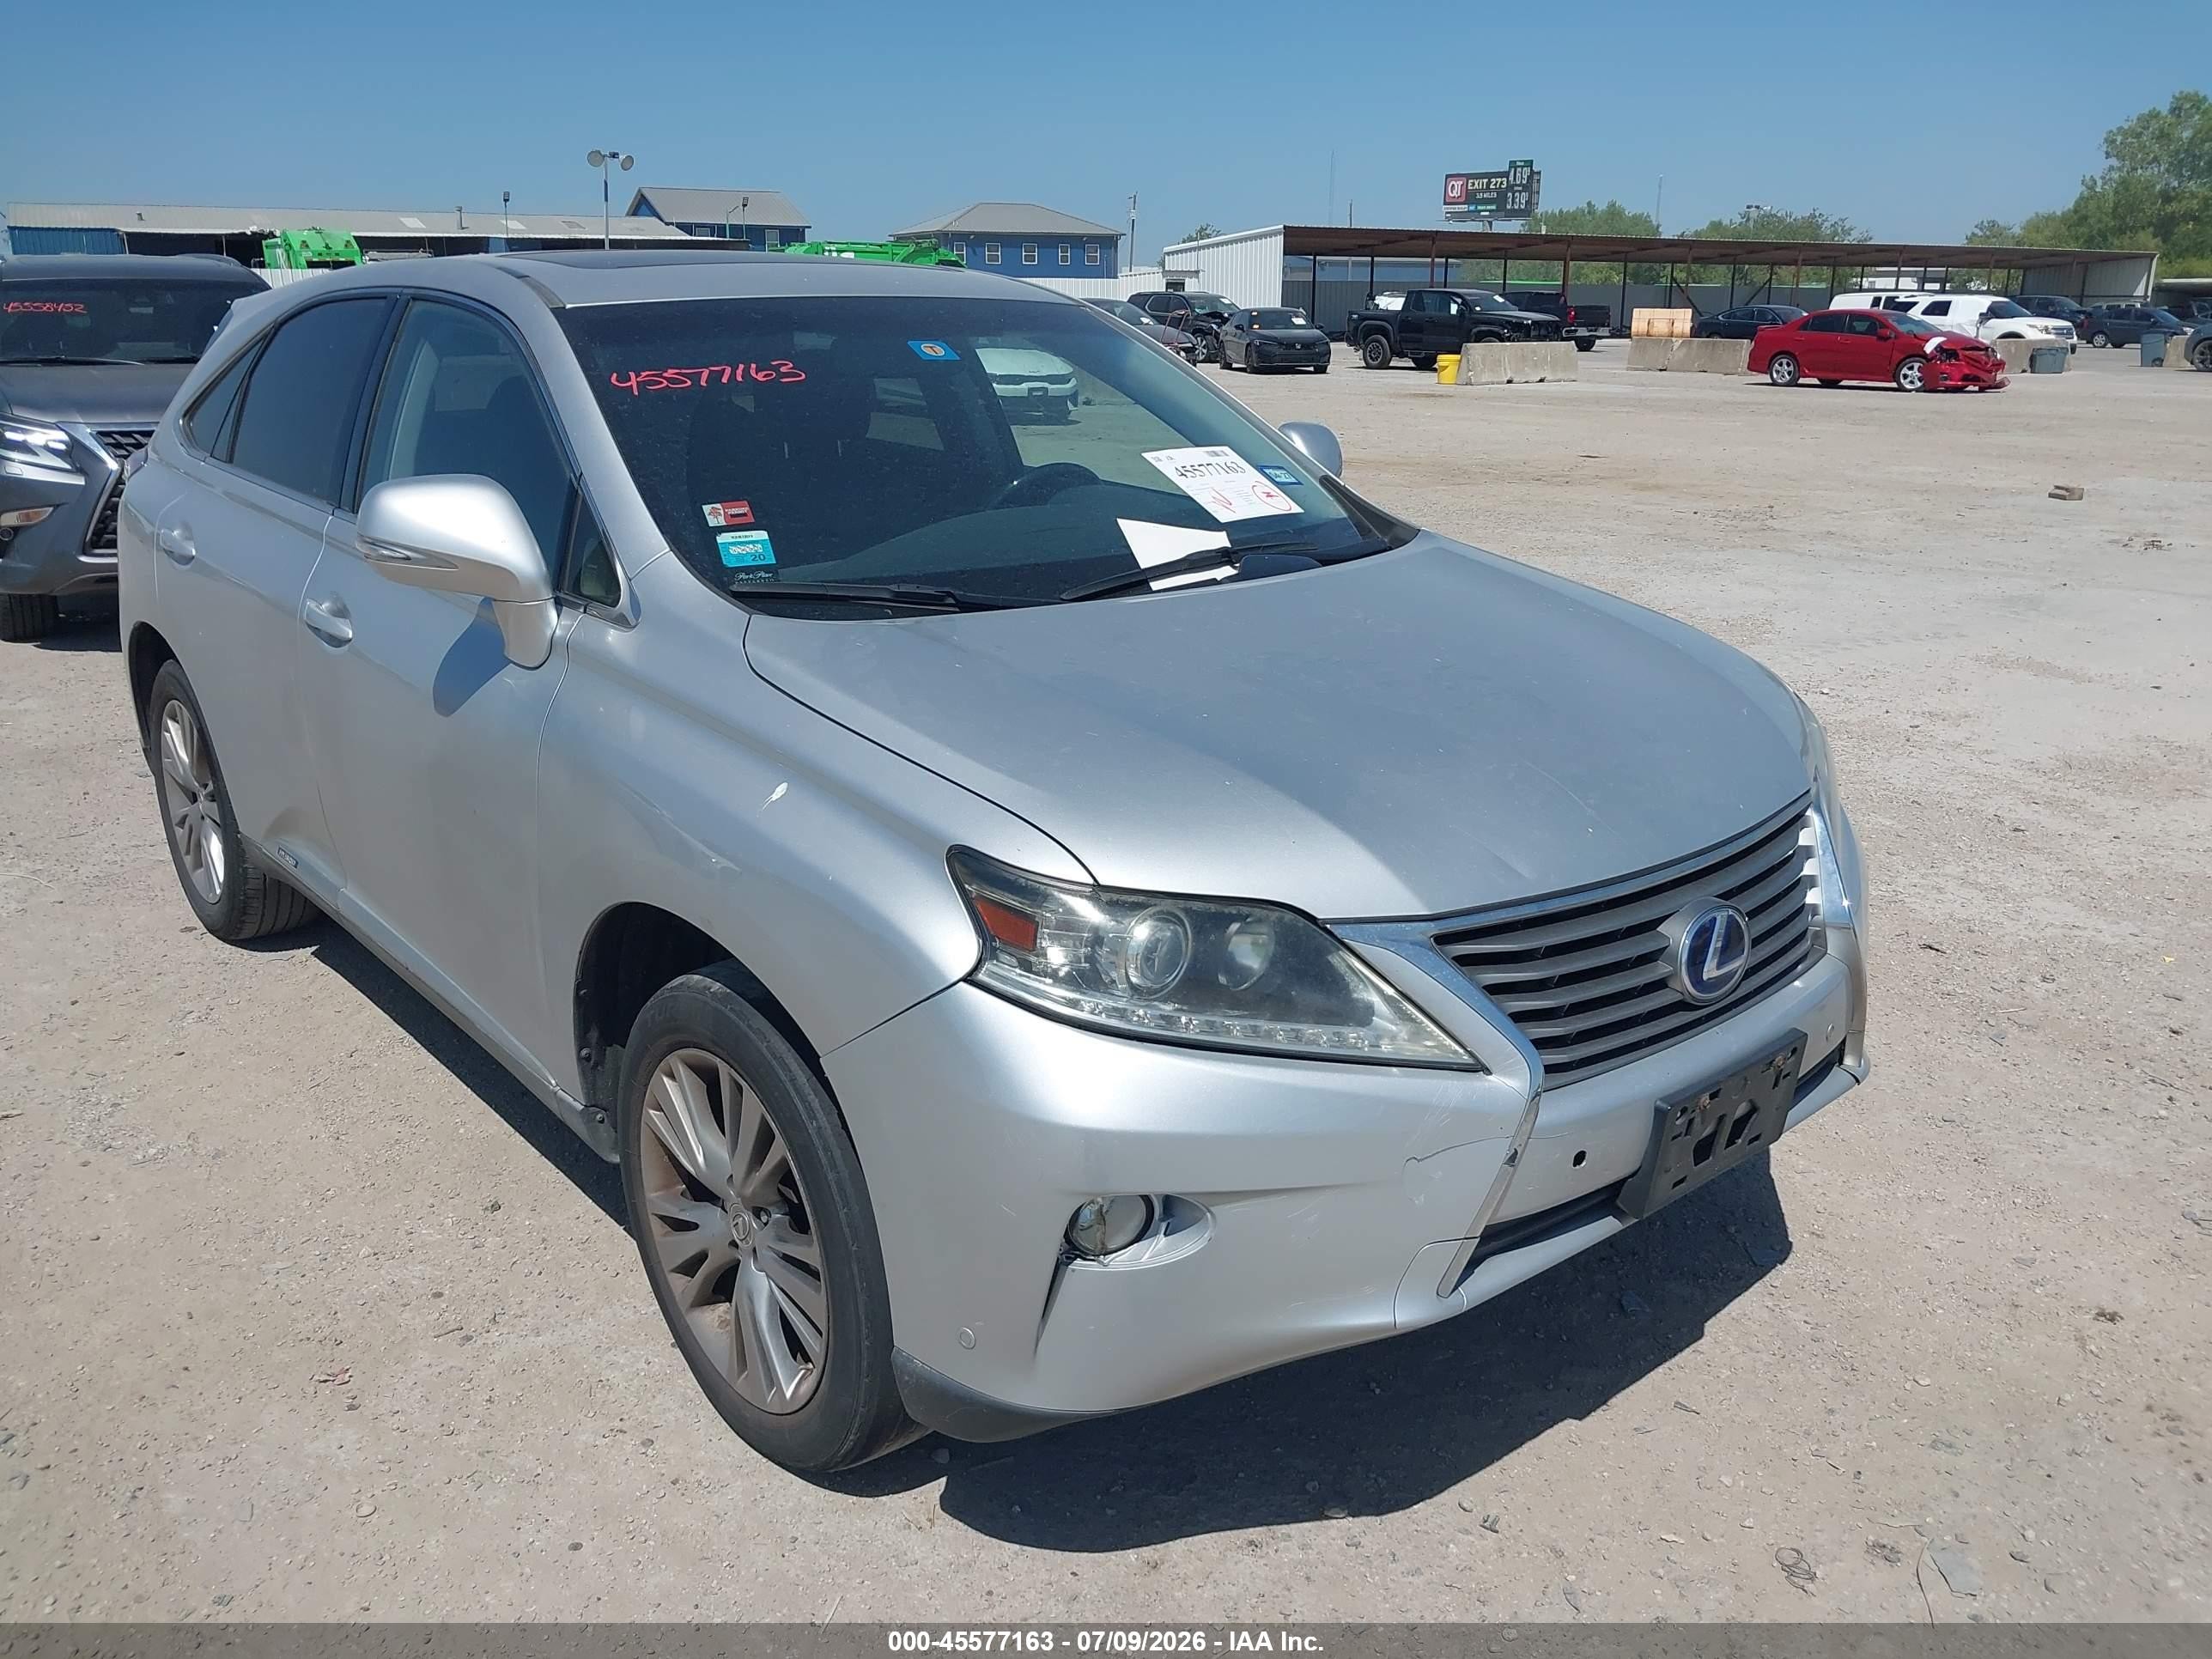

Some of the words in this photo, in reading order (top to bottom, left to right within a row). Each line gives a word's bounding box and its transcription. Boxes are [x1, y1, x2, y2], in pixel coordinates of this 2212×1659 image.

[1448, 180, 1463, 198] QT
[1468, 178, 1488, 189] EXIT
[1490, 177, 1507, 189] 273
[611, 360, 806, 396] 45577163
[1174, 461, 1246, 478] 45577163
